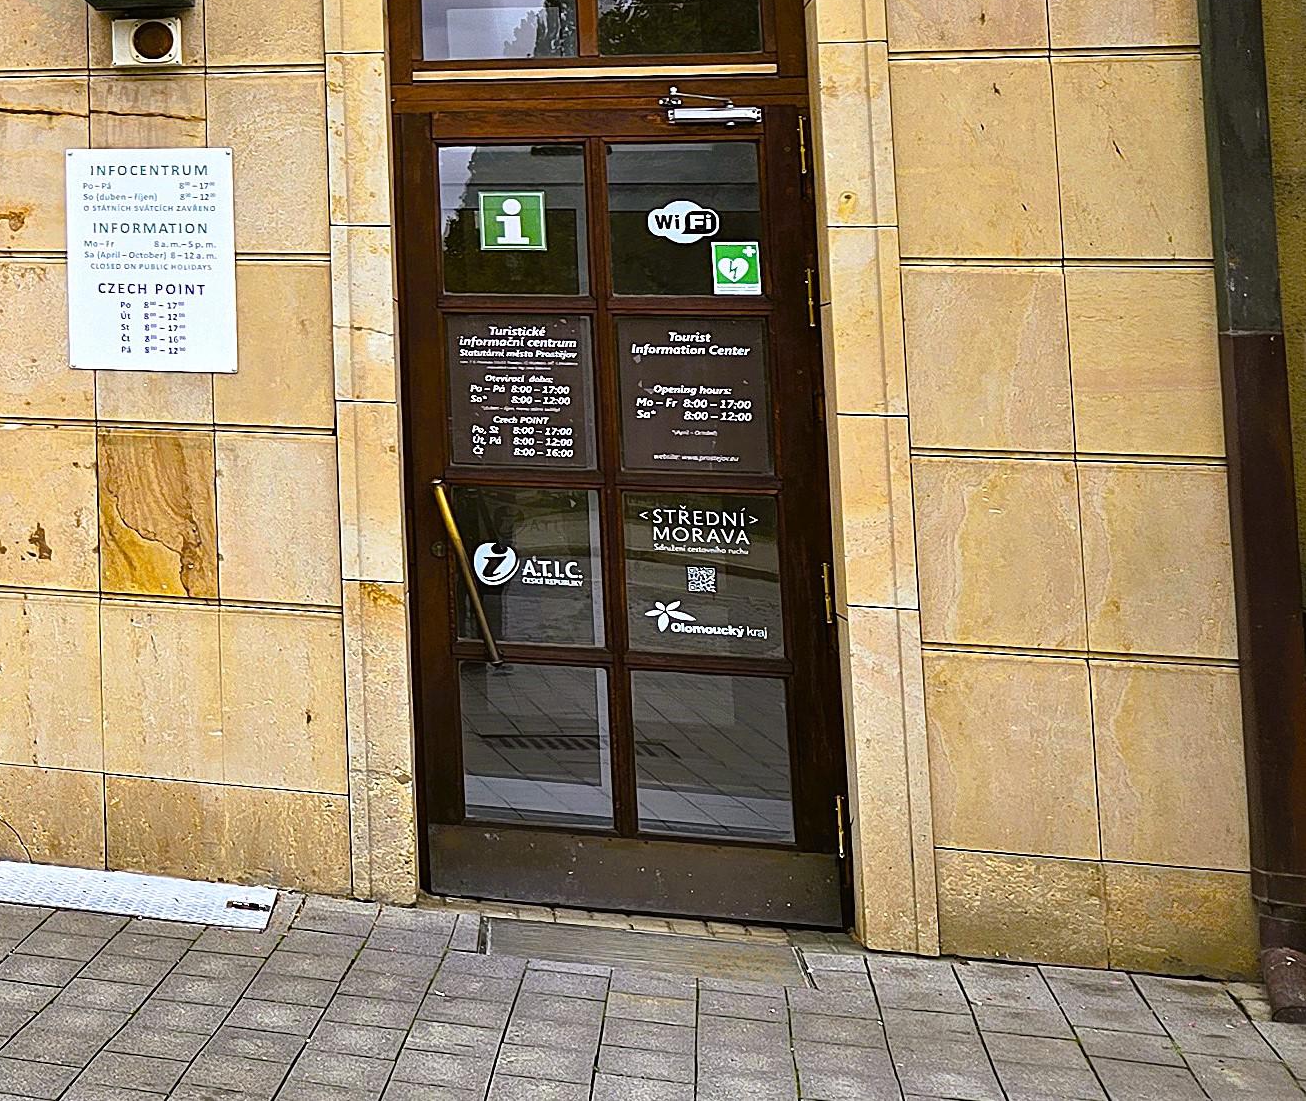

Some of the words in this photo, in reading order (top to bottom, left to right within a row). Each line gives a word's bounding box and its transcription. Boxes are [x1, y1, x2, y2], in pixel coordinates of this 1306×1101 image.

[90, 164, 208, 176] INFOCENTRUM
[176, 204, 216, 212] ZAVŘENO
[93, 222, 208, 234] INFORMATION
[97, 251, 121, 259] (April
[128, 251, 167, 260] October)
[98, 282, 147, 294] CZECH
[156, 284, 206, 295] POINT
[489, 326, 546, 336] Turistické
[668, 331, 711, 343] Tourist
[459, 336, 525, 348] informační
[526, 339, 577, 348] centrum
[631, 343, 706, 356] Information
[709, 345, 750, 356] Center
[470, 384, 482, 392] Po
[492, 384, 506, 393] Pá
[510, 385, 532, 394] 8:00
[542, 386, 570, 394] 17:00
[653, 384, 697, 396] Opening
[699, 386, 732, 395] hours:
[511, 396, 532, 404] 8:00
[542, 396, 571, 405] 12:00
[636, 397, 654, 407] Mo
[665, 398, 678, 408] Fr
[682, 399, 708, 408] 8:00
[720, 400, 752, 409] 17:00
[684, 411, 708, 421] 8:00
[720, 412, 752, 422] 12:00
[512, 426, 534, 435] 8:00
[545, 427, 573, 436] 17:00
[489, 436, 502, 445] Pá
[513, 437, 535, 445] 8:00
[545, 438, 573, 446] 12:00
[513, 448, 535, 456] 8:00
[546, 448, 574, 457] 16:00
[652, 527, 751, 545] MORAVA
[728, 547, 749, 555] ruchu
[522, 560, 584, 578] A.T.I.C.
[670, 622, 744, 638] Olomoucký
[746, 626, 768, 639] kraj
